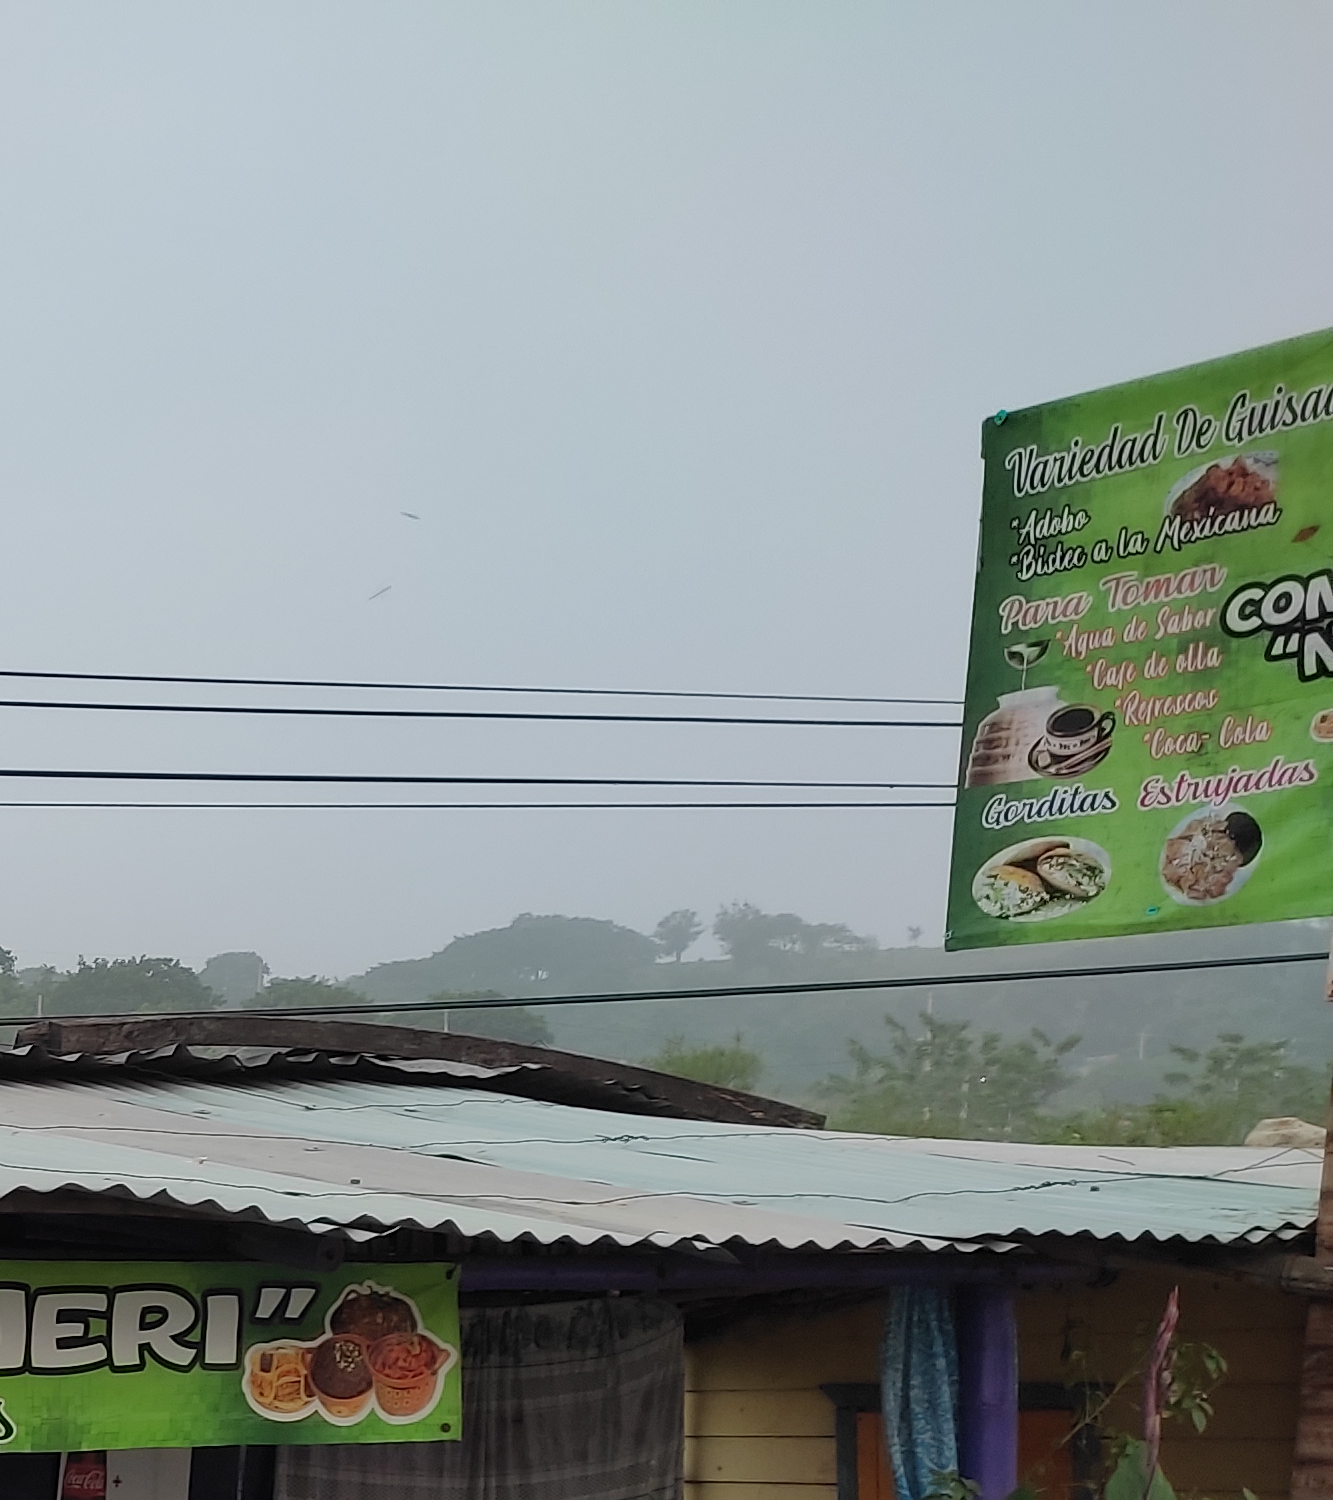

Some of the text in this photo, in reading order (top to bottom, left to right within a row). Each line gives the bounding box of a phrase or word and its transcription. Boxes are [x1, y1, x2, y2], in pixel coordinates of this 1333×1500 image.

[1007, 414, 1166, 496] Variedad
[1175, 405, 1216, 457] De
[1017, 502, 1281, 580] Bistec a la Mexicana
[1018, 505, 1089, 545] Adobo
[1000, 563, 1226, 634] Para Tomar
[1062, 605, 1216, 659] Agua de Sabor
[1144, 652, 1168, 679] de
[1176, 641, 1221, 673] olla
[1123, 689, 1218, 726] Refrescos
[1220, 716, 1271, 749] Cola
[983, 756, 1318, 828] Gorditas Estrujadas
